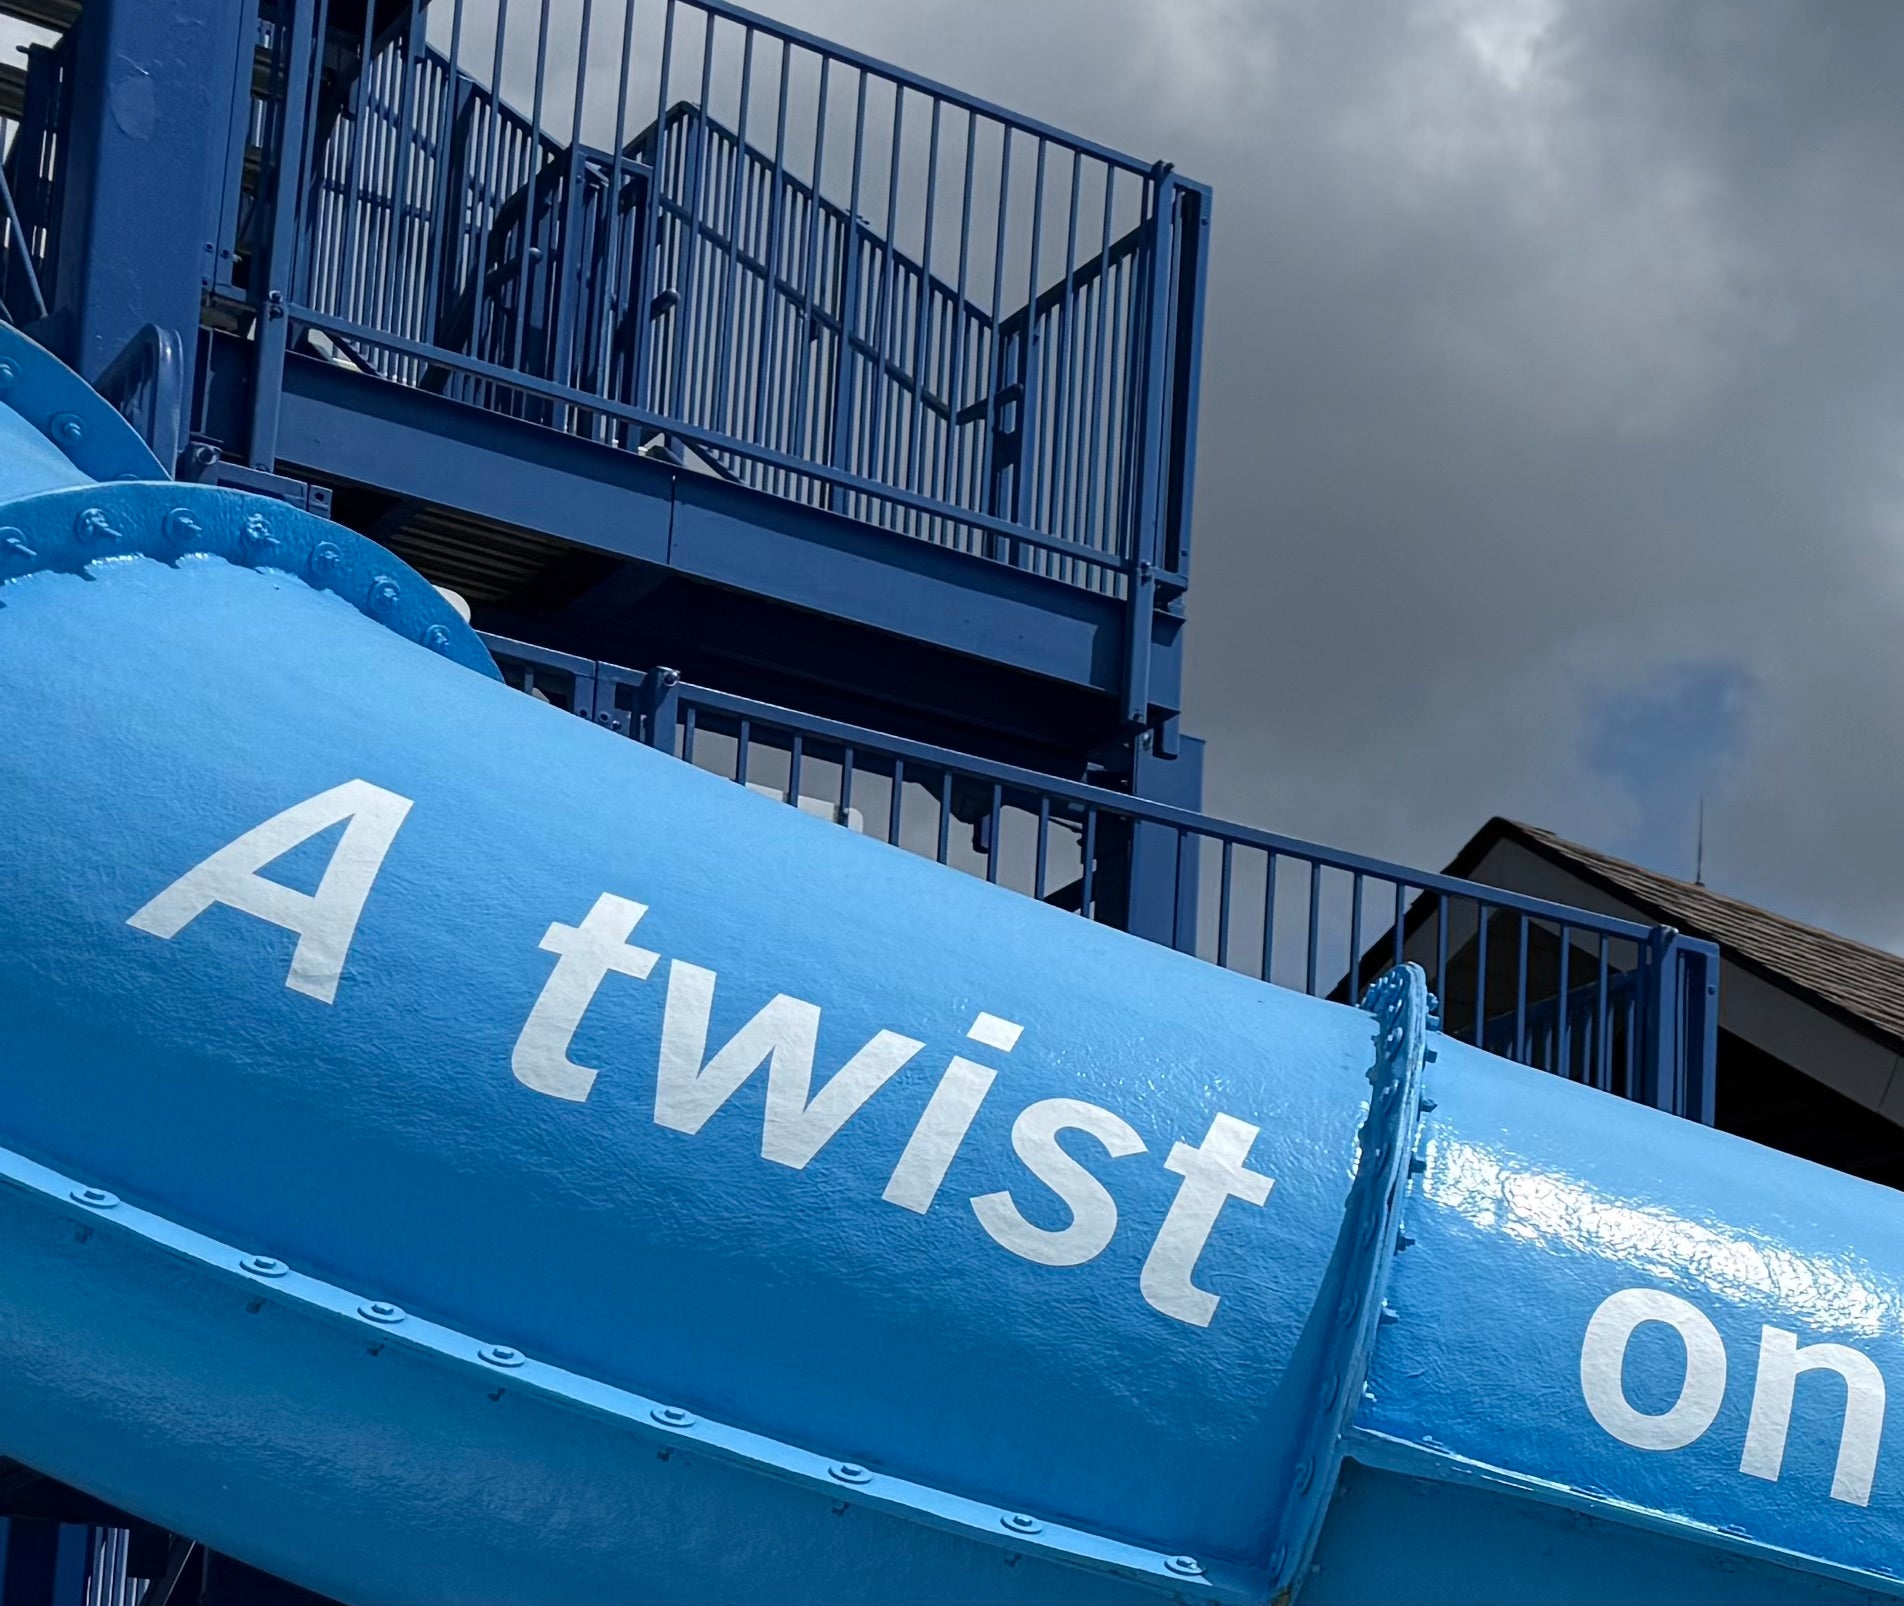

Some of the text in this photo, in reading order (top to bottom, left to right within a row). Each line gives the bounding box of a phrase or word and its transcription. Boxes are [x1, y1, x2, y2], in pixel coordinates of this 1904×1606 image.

[128, 778, 414, 1004] A
[510, 891, 1275, 1328] twist
[1580, 1286, 1886, 1507] on
